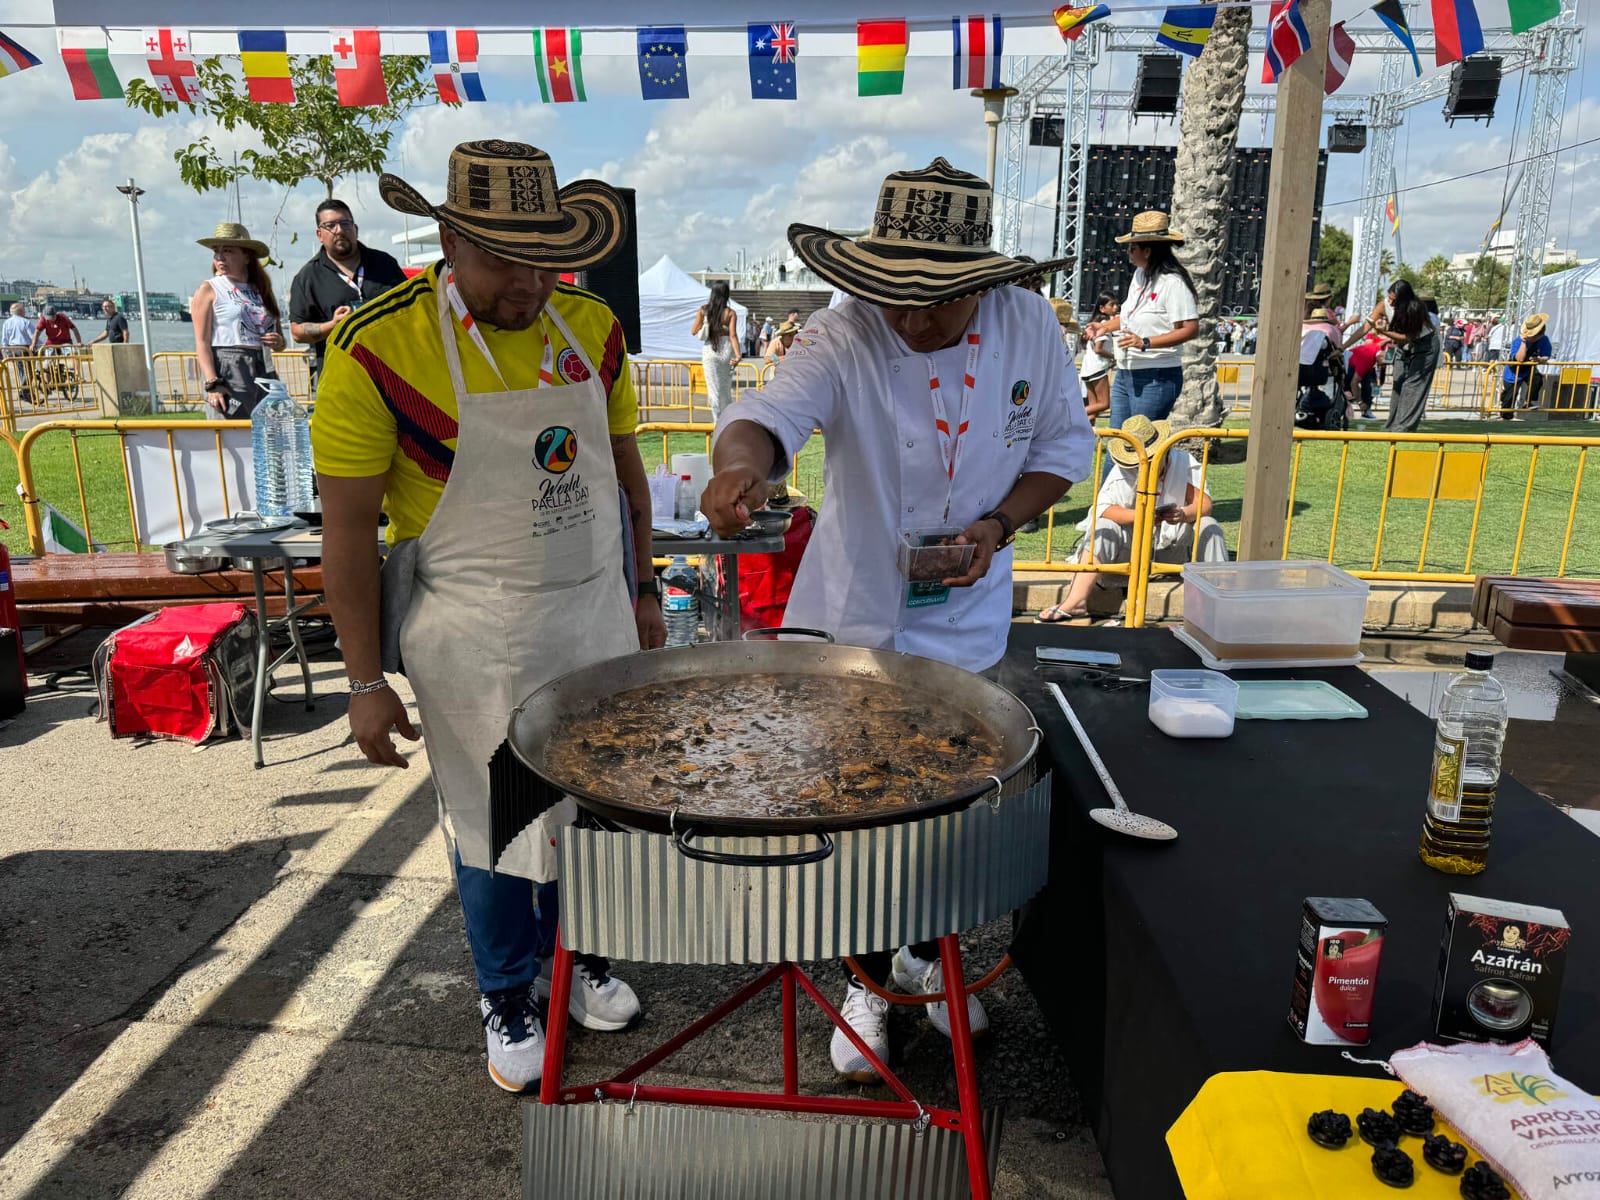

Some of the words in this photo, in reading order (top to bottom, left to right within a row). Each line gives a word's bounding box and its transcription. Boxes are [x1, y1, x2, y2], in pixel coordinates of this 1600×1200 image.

[539, 473, 580, 499] World
[531, 492, 572, 511] PAELLA
[575, 485, 590, 502] DAY
[1470, 949, 1542, 974] Azafrán
[1474, 964, 1505, 976] Saffron
[1328, 976, 1369, 986] Pimentón
[1339, 984, 1357, 992] dulce
